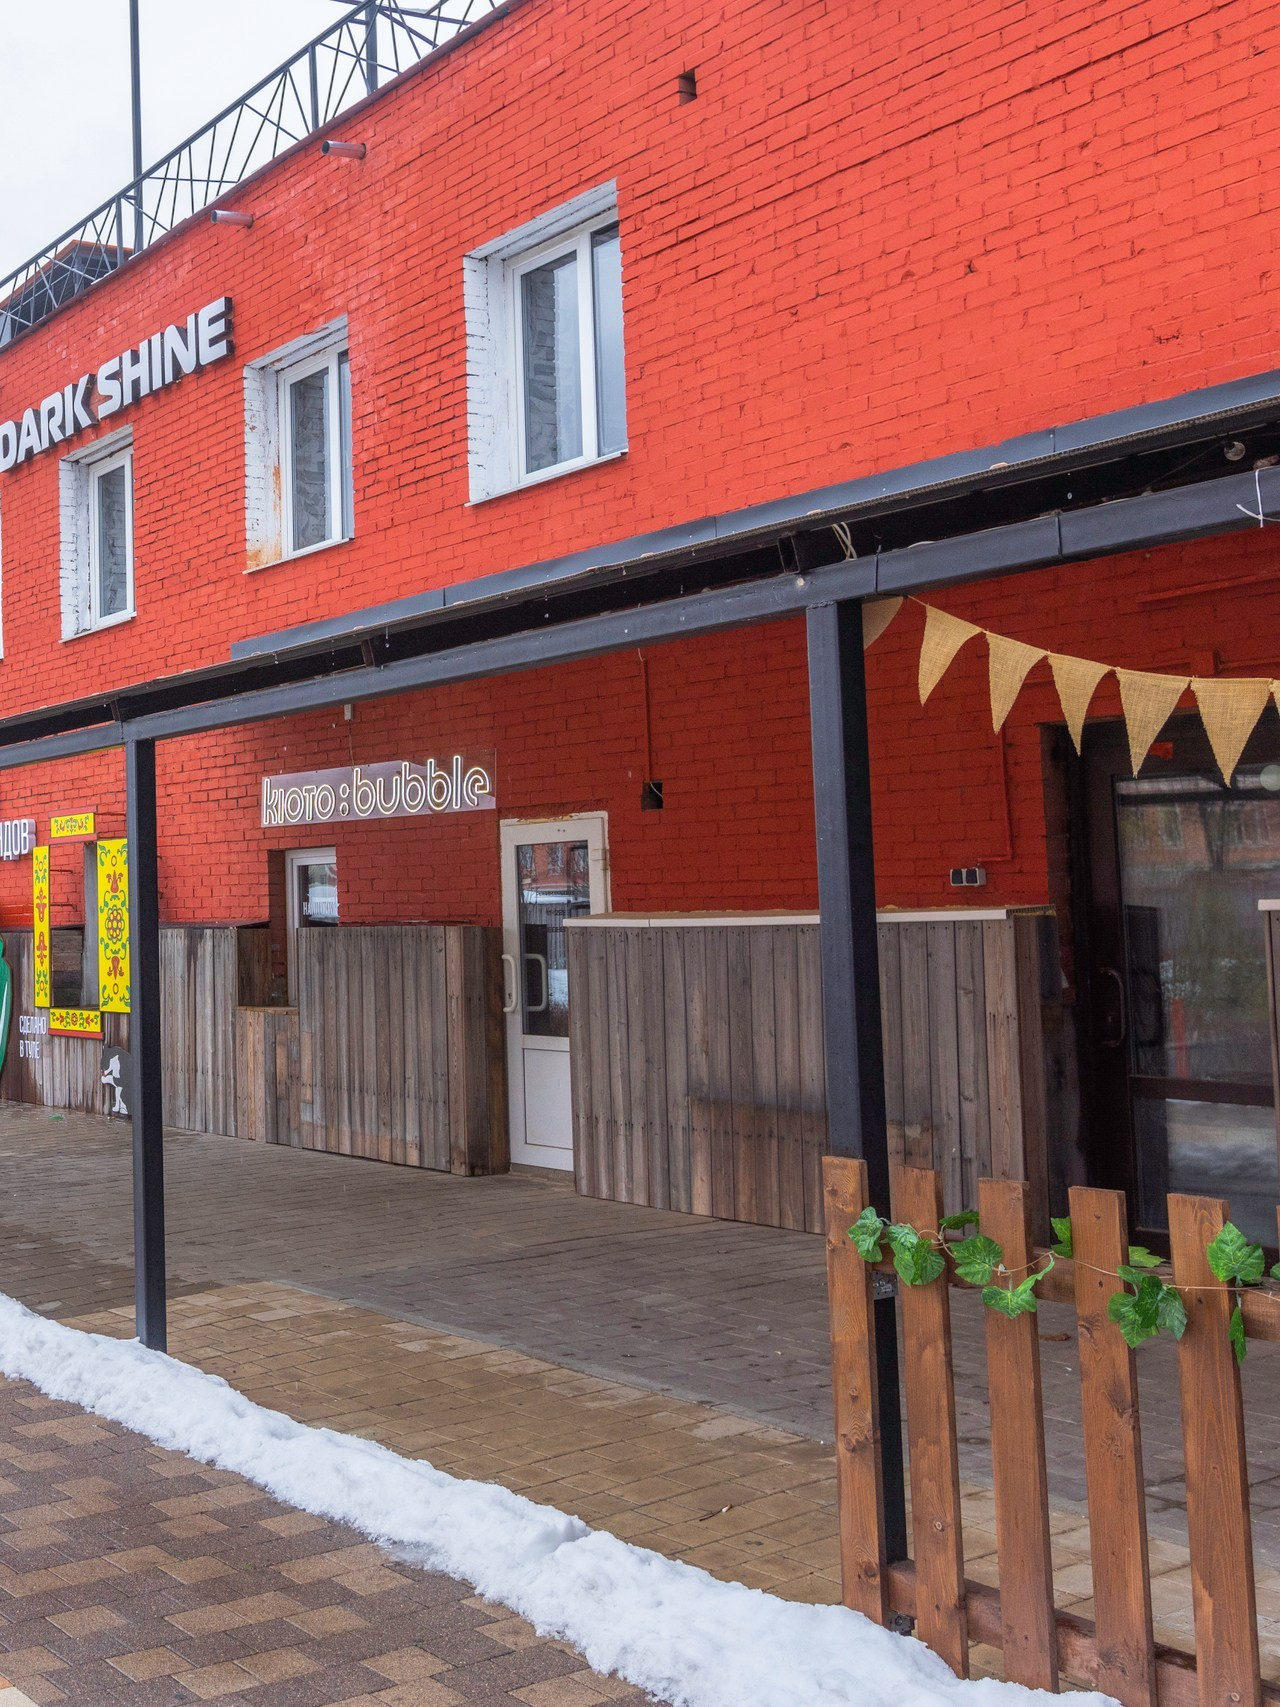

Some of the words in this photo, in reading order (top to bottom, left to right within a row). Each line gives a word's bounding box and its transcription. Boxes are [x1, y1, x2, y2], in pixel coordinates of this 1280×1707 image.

[97, 296, 235, 421] SHINE
[19, 1015, 47, 1036] СДЕЛАНО
[19, 1040, 25, 1058] В
[24, 1040, 41, 1059] ТУЛЕ
